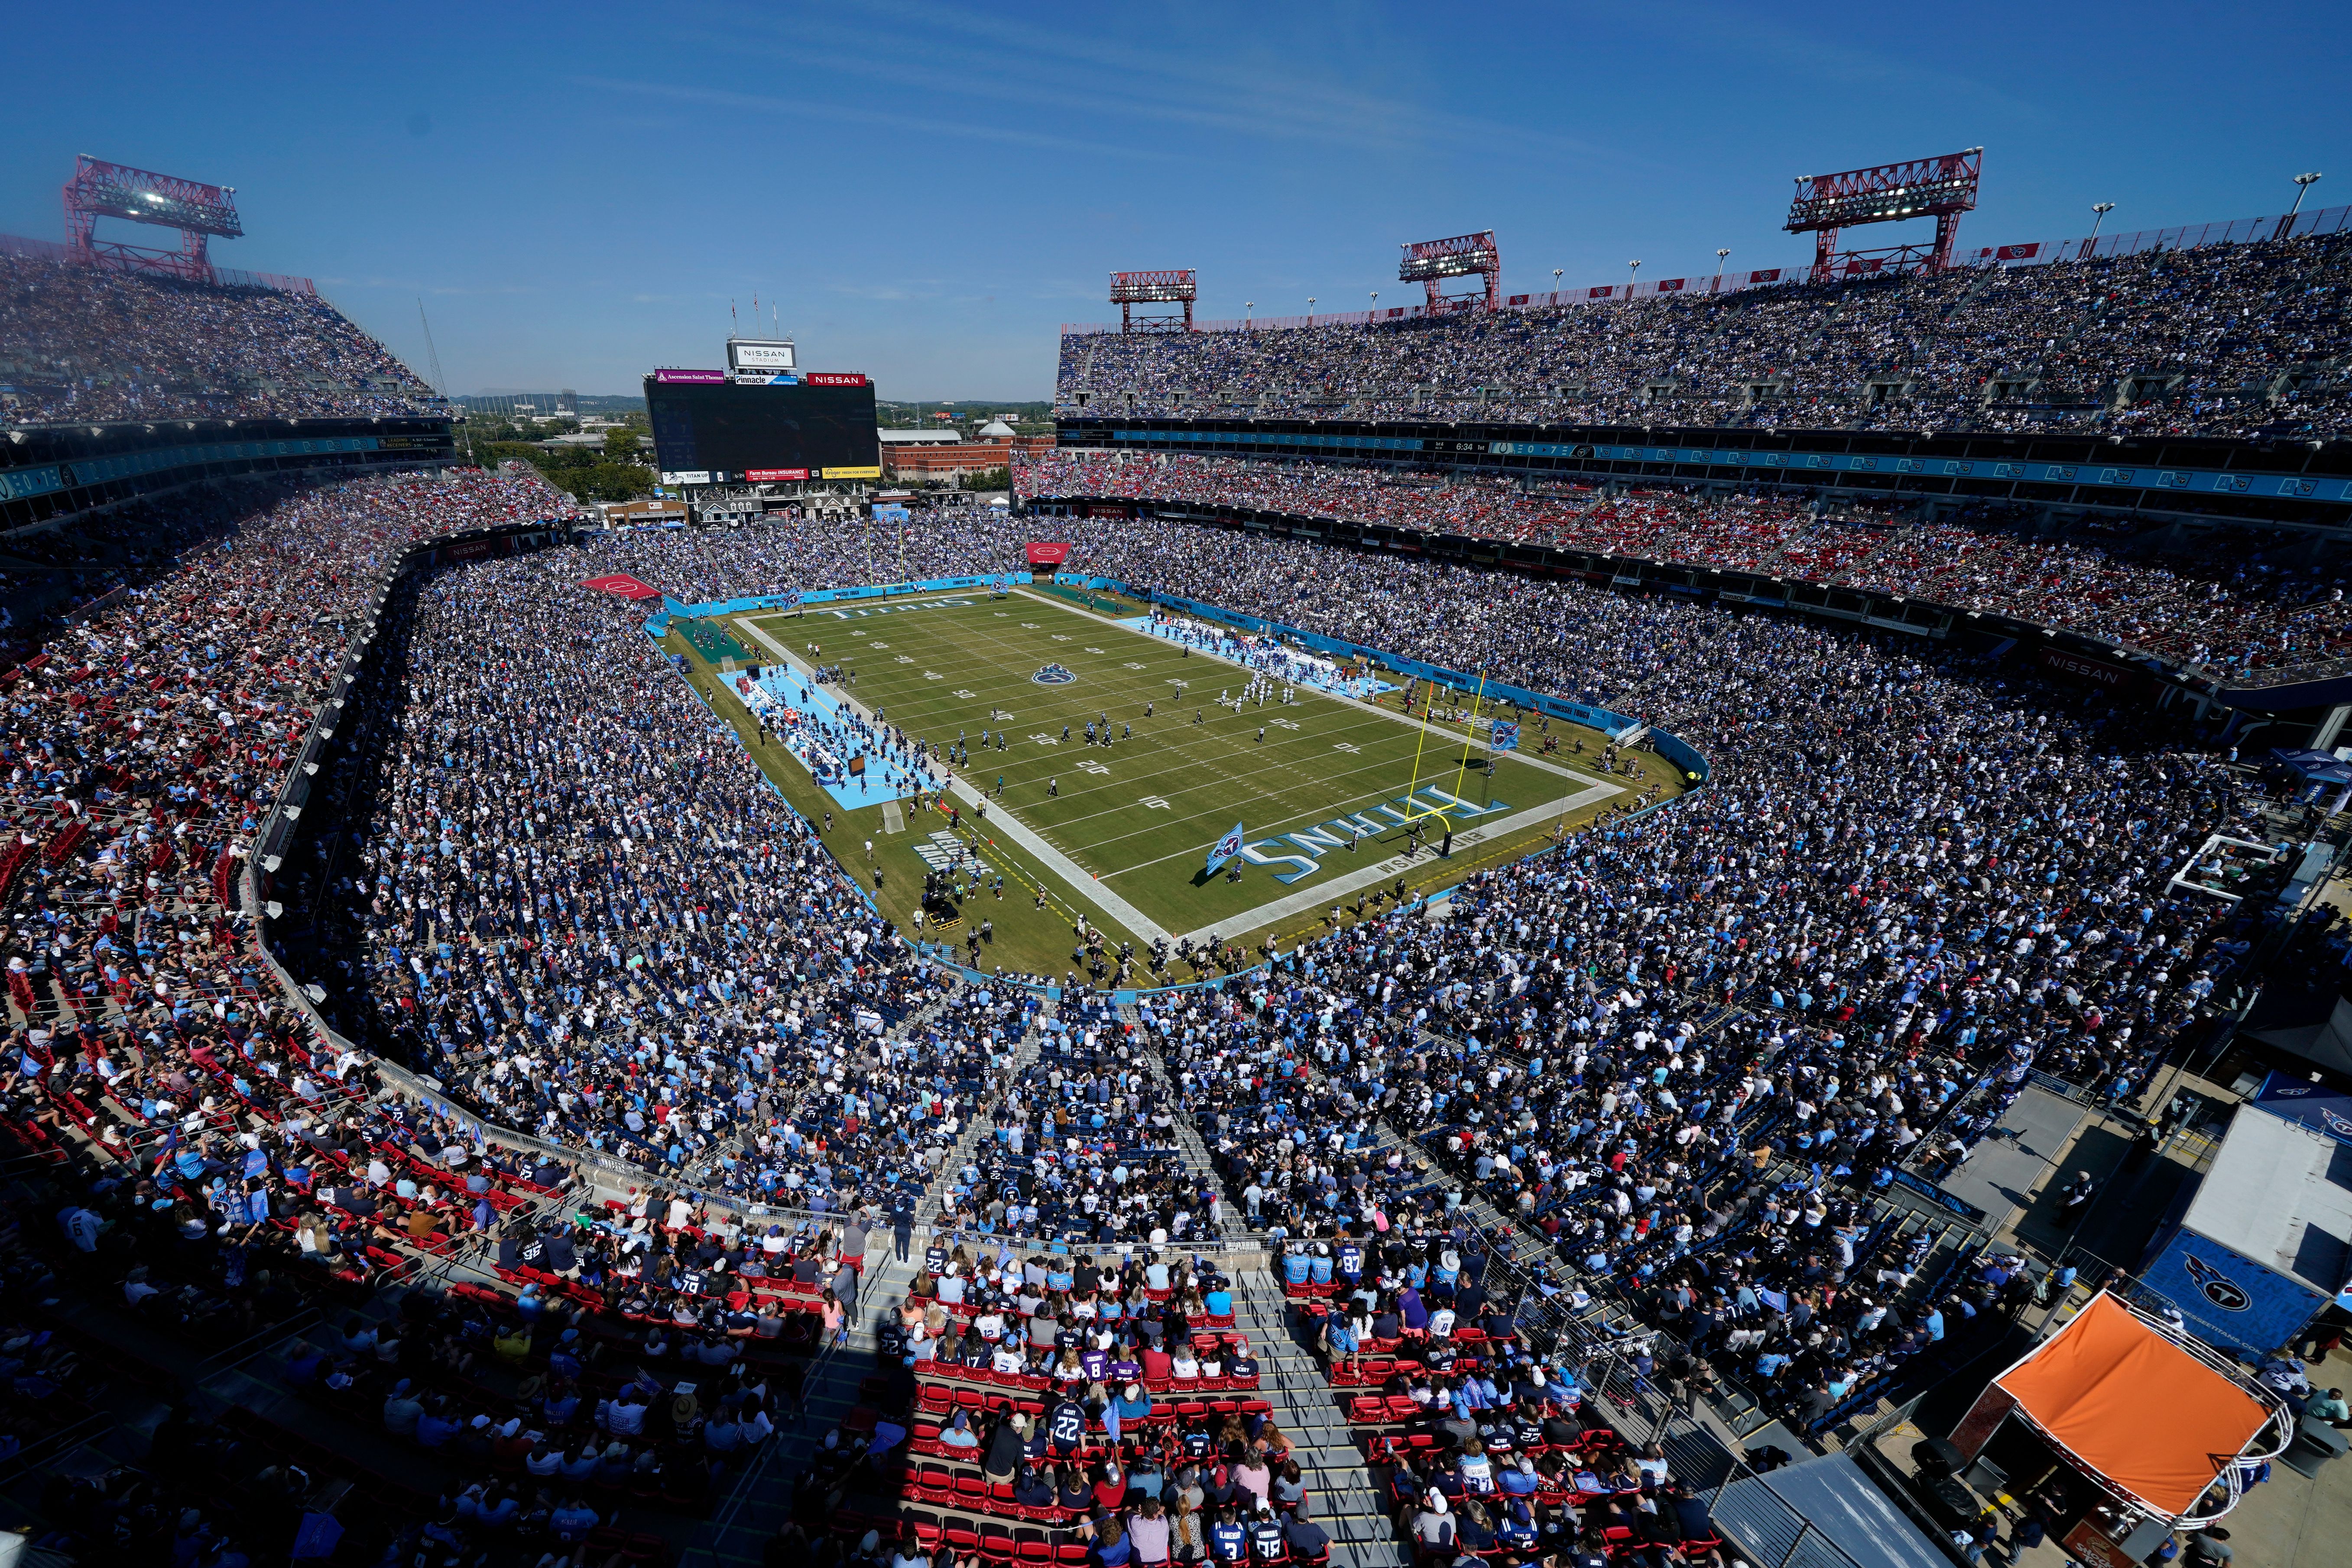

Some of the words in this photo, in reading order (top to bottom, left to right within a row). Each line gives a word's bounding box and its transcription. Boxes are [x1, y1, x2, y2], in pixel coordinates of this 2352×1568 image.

[736, 376, 766, 384] Pinnacle
[1528, 445, 1534, 453] 0
[825, 469, 840, 478] Kroger
[454, 544, 486, 556] NISSAN
[1719, 592, 1746, 601] Pinnacle
[817, 596, 976, 621] TITANS
[2048, 655, 2118, 684] NISSAN
[1433, 670, 1453, 683] TENNESSEE
[1453, 677, 1466, 686] TOUGH
[952, 689, 977, 699] 50
[1547, 701, 1573, 715] TENNESSEE
[1573, 708, 1590, 719] TOUGH
[1268, 718, 1300, 729] 20
[1028, 732, 1058, 745] 30
[1333, 742, 1361, 753] 10
[1076, 759, 1110, 775] 20
[1138, 795, 1170, 809] 10
[1236, 783, 1513, 885] TITANS
[1452, 832, 1486, 851] END
[911, 842, 951, 873] BACK
[926, 830, 995, 876] WELCOME
[1377, 843, 1444, 875] ACISM
[1440, 1048, 1450, 1056] 22
[1300, 1098, 1308, 1108] 38
[876, 1158, 883, 1169] 8
[1590, 1168, 1604, 1178] 59
[765, 1178, 771, 1186] 7
[1891, 1169, 1937, 1200] ENNESSEE
[927, 1257, 943, 1273] 22
[1343, 1255, 1360, 1273] 87
[685, 1273, 699, 1281] SPARKS
[1292, 1267, 1307, 1279] 17
[1315, 1267, 1329, 1281] 17
[681, 1279, 699, 1294] 79
[983, 1329, 994, 1338] 12
[1440, 1322, 1449, 1332] 8
[881, 1338, 899, 1355] 22
[1087, 1354, 1103, 1363] COUSINS
[1091, 1363, 1100, 1378] 8
[1054, 1416, 1080, 1441] 22
[1520, 1432, 1541, 1442] 22
[1219, 1530, 1241, 1540] BLANKENSHIP
[1258, 1529, 1278, 1539] SIMMONS
[1224, 1542, 1238, 1560] 3
[1256, 1539, 1280, 1558] 98
[2076, 1542, 2115, 1568] SHOCK
